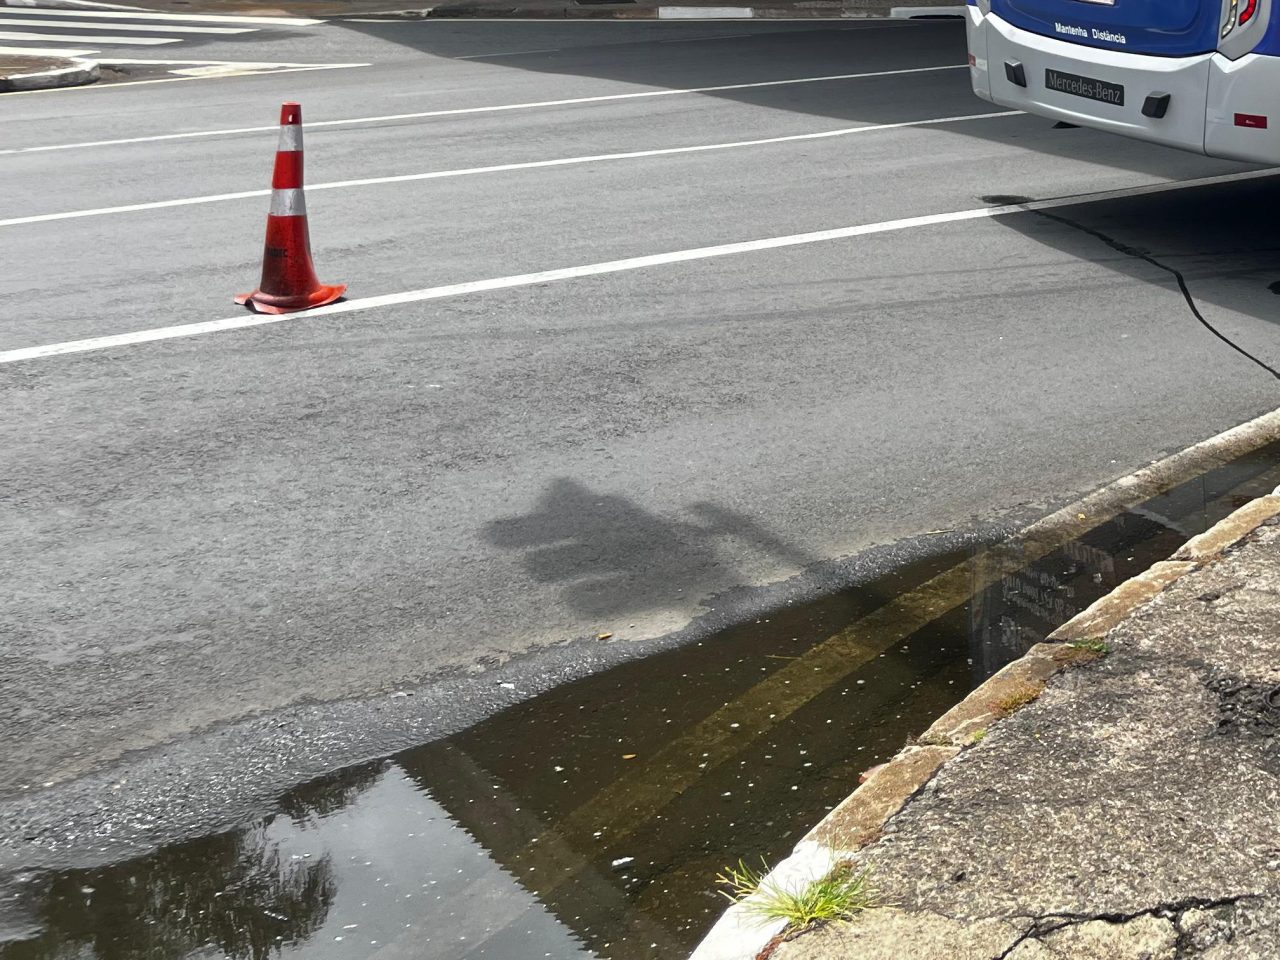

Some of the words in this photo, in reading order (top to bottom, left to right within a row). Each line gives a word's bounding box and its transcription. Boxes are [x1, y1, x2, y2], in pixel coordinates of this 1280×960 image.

[1055, 22, 1088, 38] Mantenha
[1091, 28, 1126, 44] Distância
[1048, 71, 1121, 103] Mercedes-Benz
